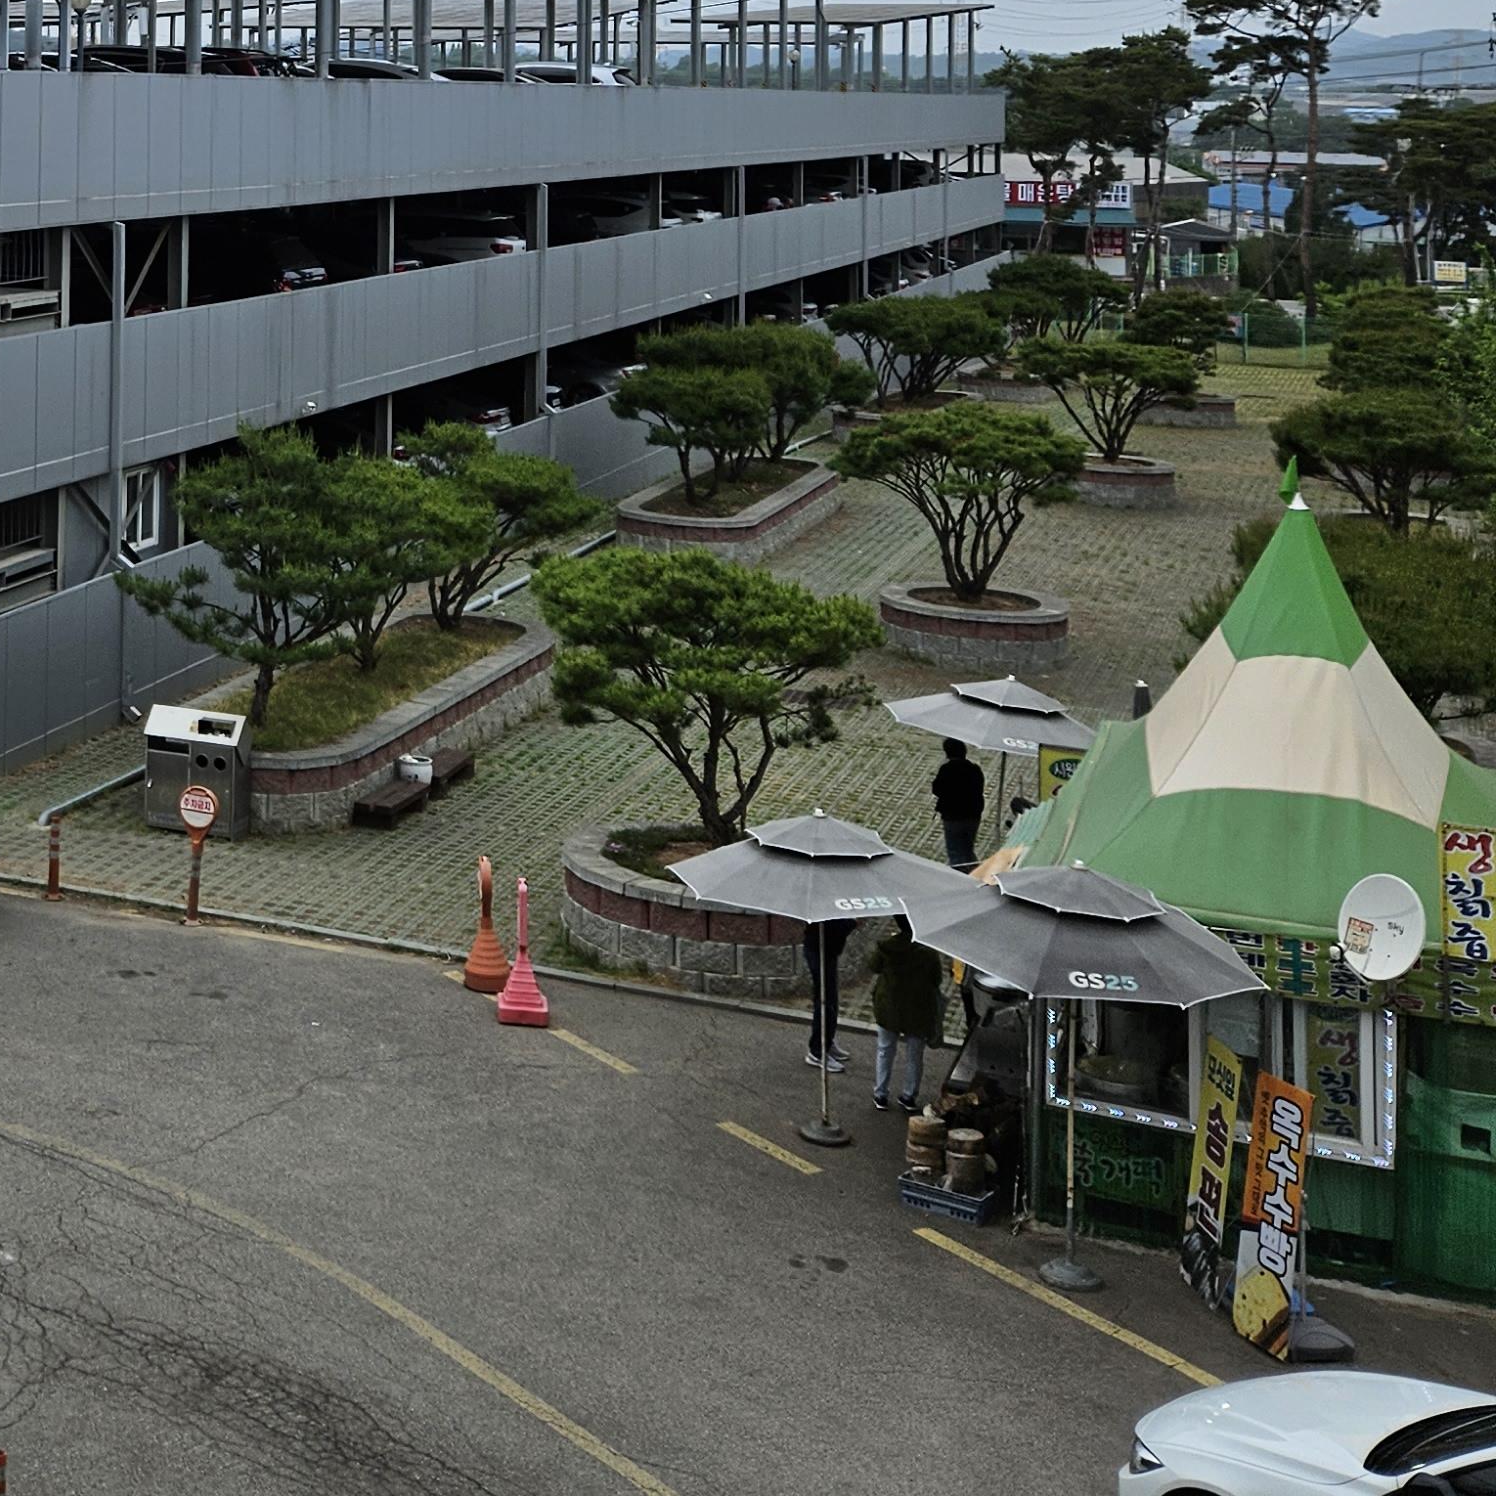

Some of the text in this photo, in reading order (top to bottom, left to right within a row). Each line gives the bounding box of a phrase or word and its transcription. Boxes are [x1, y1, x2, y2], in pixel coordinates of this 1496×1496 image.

[1003, 736, 1040, 750] GS2
[184, 797, 211, 811] 주차금지
[835, 896, 893, 911] GS25
[1445, 832, 1493, 960] 생칡즙
[1068, 971, 1140, 992] GS25
[1196, 1102, 1230, 1244] 송편
[1257, 1095, 1304, 1278] 옥수수빵
